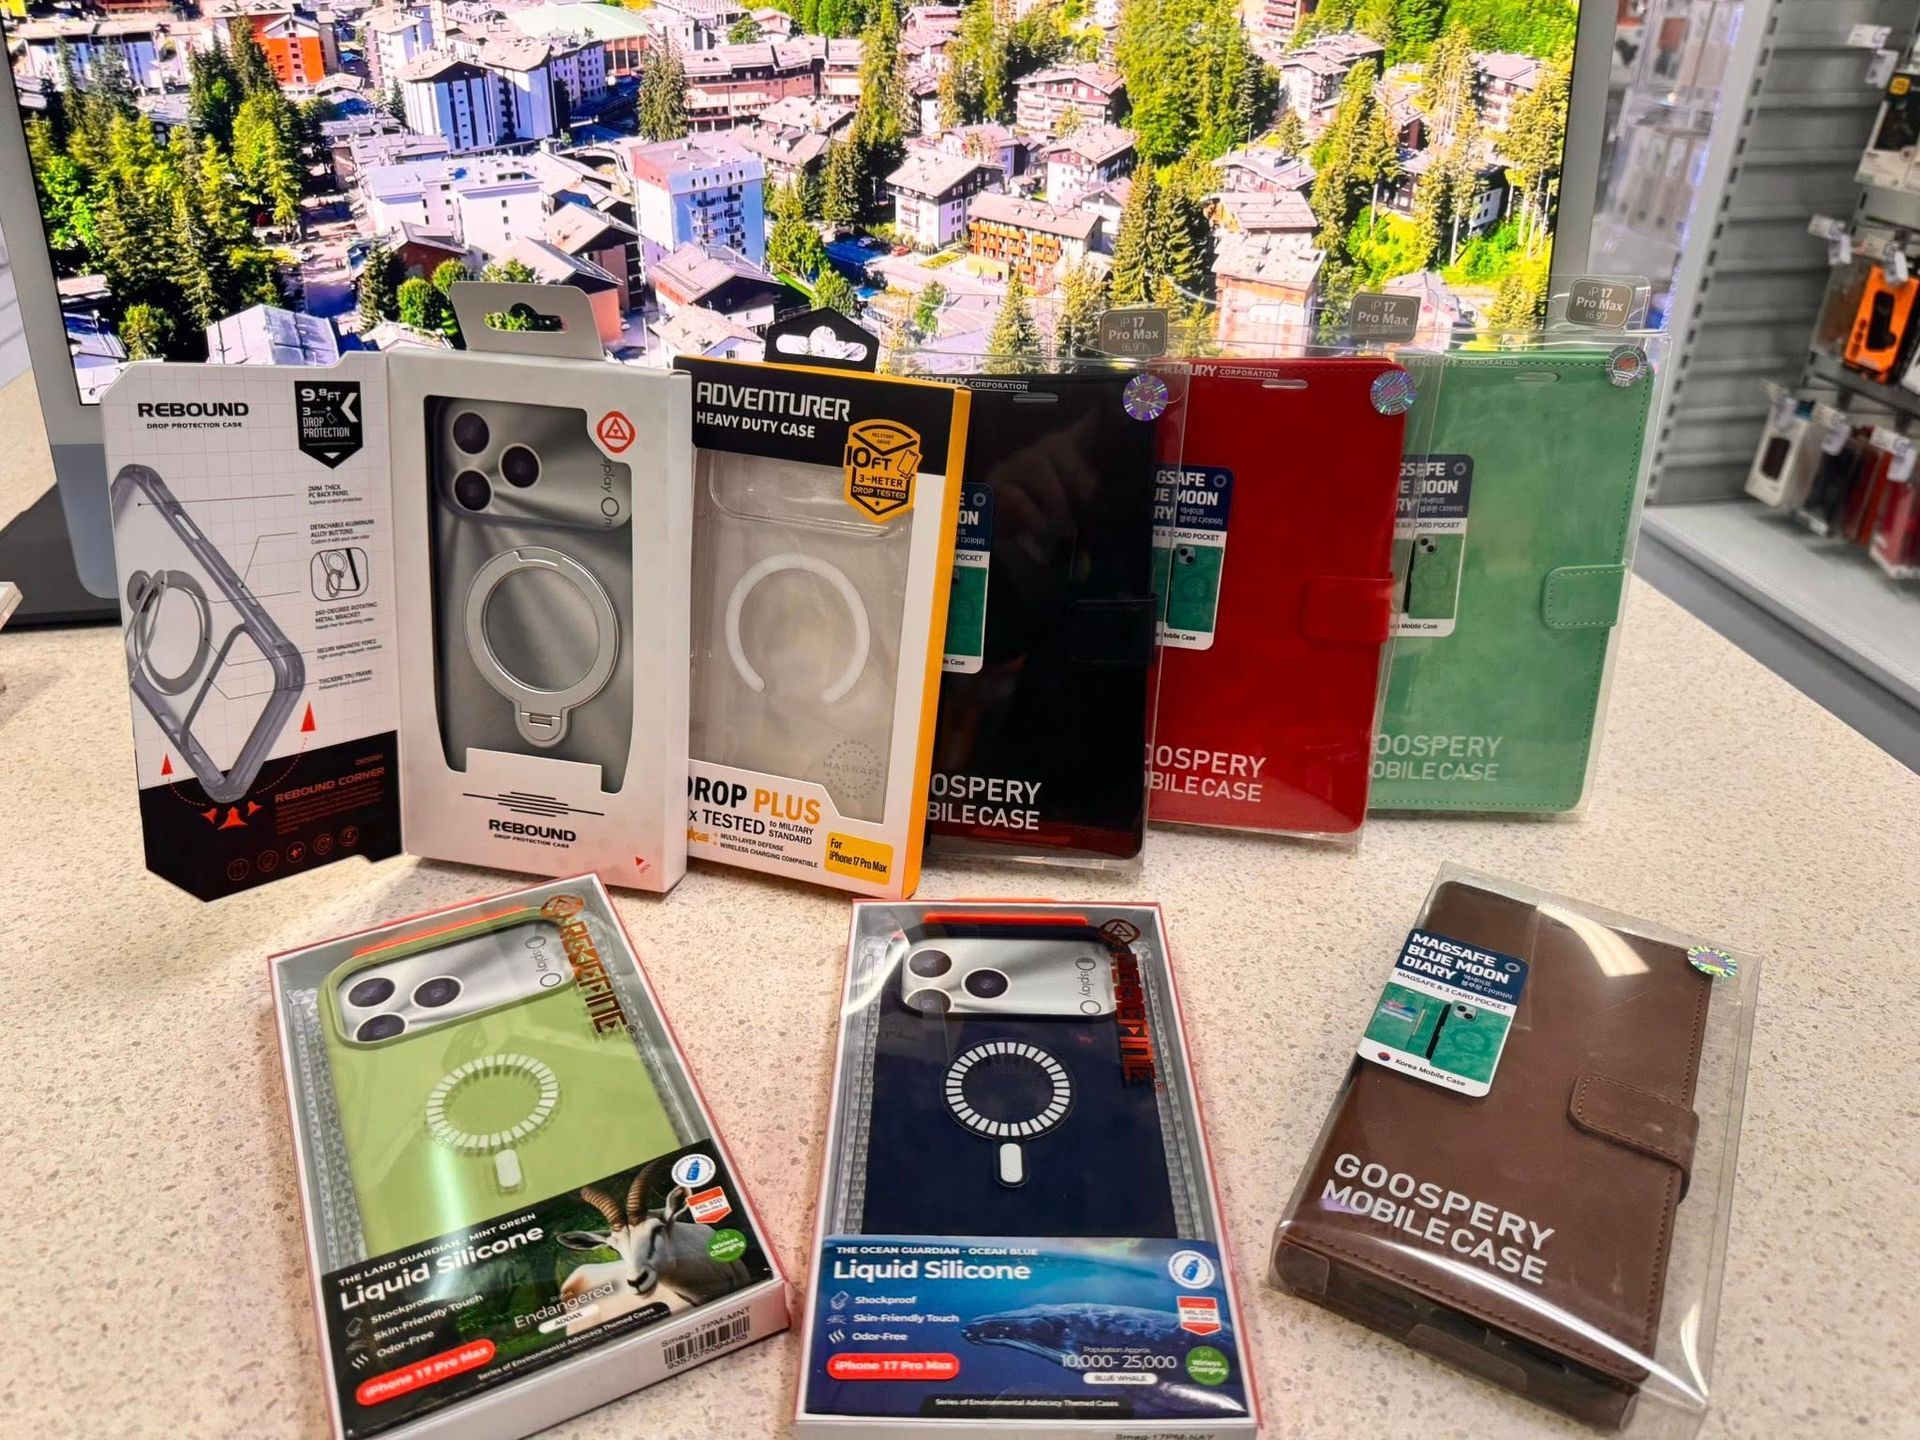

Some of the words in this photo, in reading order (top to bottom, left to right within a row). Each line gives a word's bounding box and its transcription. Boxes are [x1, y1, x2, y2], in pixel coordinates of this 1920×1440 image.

[1600, 286, 1614, 298] 17
[1384, 301, 1397, 312] 17
[1575, 296, 1597, 309] Pro
[1598, 298, 1624, 312] Max
[1132, 316, 1145, 328] 17
[1357, 311, 1380, 323] Pro
[1382, 313, 1409, 326] Max
[1108, 330, 1130, 340] Pro
[1133, 328, 1160, 340] Max
[1219, 367, 1279, 378] CORPORATION
[970, 380, 1029, 390] CORPORATION
[137, 402, 249, 417] REBOUND
[696, 381, 850, 422] ADVENTURER
[302, 406, 312, 416] 3
[146, 422, 169, 430] DROP
[171, 421, 220, 429] PROTECTION
[222, 420, 243, 428] CASE
[302, 416, 325, 428] DROP
[696, 411, 740, 428] HEAVY
[742, 418, 778, 434] DUTY
[780, 422, 816, 439] CASE
[303, 426, 351, 438] PROTECTION
[858, 474, 903, 488] 3-METER
[852, 486, 874, 494] DROP
[876, 489, 906, 500] TESTED
[1192, 533, 1220, 542] POCKET
[275, 780, 336, 804] REBOUND
[338, 767, 385, 786] CORNER
[753, 788, 821, 825] PLUS
[488, 818, 577, 842] REBOUND
[702, 808, 766, 836] TESTED
[769, 820, 778, 828] to
[778, 822, 814, 836] MILITARY
[720, 832, 756, 846] MULTI-LAYER
[757, 840, 784, 852] DEFENSE
[768, 830, 812, 845] STANDARD
[830, 838, 844, 850] For
[720, 842, 749, 855] WIRELESS
[750, 848, 781, 861] CHARGING
[781, 854, 818, 868] COMPATIBLE
[829, 851, 853, 866] iPhone
[853, 856, 860, 866] 17
[860, 857, 872, 869] Pro
[872, 860, 888, 874] Max
[1412, 932, 1497, 968] MAGSAFE
[1402, 955, 1458, 980] DIARY
[1407, 944, 1454, 967] BLUE
[1455, 959, 1510, 985] MOON
[1397, 972, 1437, 989] MAGSAFE
[1450, 989, 1474, 1001] CARD
[1474, 997, 1510, 1012] POCKET
[1395, 1058, 1418, 1071] Korea
[1418, 1065, 1444, 1080] Mobile
[1446, 1075, 1466, 1087] Case
[1334, 1152, 1556, 1251] GOOSPERY
[338, 1272, 362, 1288] THE
[364, 1259, 398, 1280] LAND
[400, 1238, 461, 1266] GUARDIAN
[468, 1226, 498, 1242] MINT
[498, 1212, 537, 1230] GREEN
[836, 1246, 860, 1254] THE
[860, 1246, 900, 1254] OCEAN
[900, 1246, 960, 1256] GUARDIAN
[968, 1247, 1008, 1256] OCEAN
[1010, 1247, 1038, 1256] BLUE
[340, 1263, 430, 1311] Liquid
[435, 1226, 545, 1274] Silicone
[833, 1258, 919, 1284] Liquid
[924, 1259, 1031, 1280] Silicone
[514, 1281, 614, 1330] Endangered
[854, 1294, 918, 1306] Shockproof
[370, 1294, 436, 1324] Shockproof
[374, 1307, 448, 1341] Skin-Friendly
[448, 1294, 484, 1312] Touch
[853, 1314, 924, 1325] Skin-Friendly
[926, 1314, 960, 1323] Touch
[376, 1330, 435, 1358] Odor-Free
[478, 1368, 502, 1380] Series
[502, 1362, 512, 1372] of
[512, 1342, 567, 1368] Environmental
[567, 1328, 602, 1346] Advocacy
[603, 1316, 632, 1331] Themed
[632, 1308, 655, 1320] Cases
[852, 1332, 909, 1342] Odor-Free
[834, 1360, 880, 1371] iPhone
[883, 1360, 899, 1370] 17
[900, 1361, 925, 1371] Pro
[925, 1361, 954, 1371] Max
[1121, 1354, 1178, 1370] 25,000
[364, 1374, 414, 1398] iPhone
[416, 1366, 432, 1379] 17
[434, 1358, 459, 1372] Pro
[460, 1347, 488, 1362] Max
[1094, 1374, 1116, 1382] BLUE
[935, 1398, 959, 1406] Series
[960, 1398, 969, 1406] of
[970, 1398, 1025, 1407] Environmental
[1026, 1399, 1062, 1408] Advocacy
[1064, 1398, 1095, 1407] Themed
[1096, 1399, 1120, 1407] Cases
